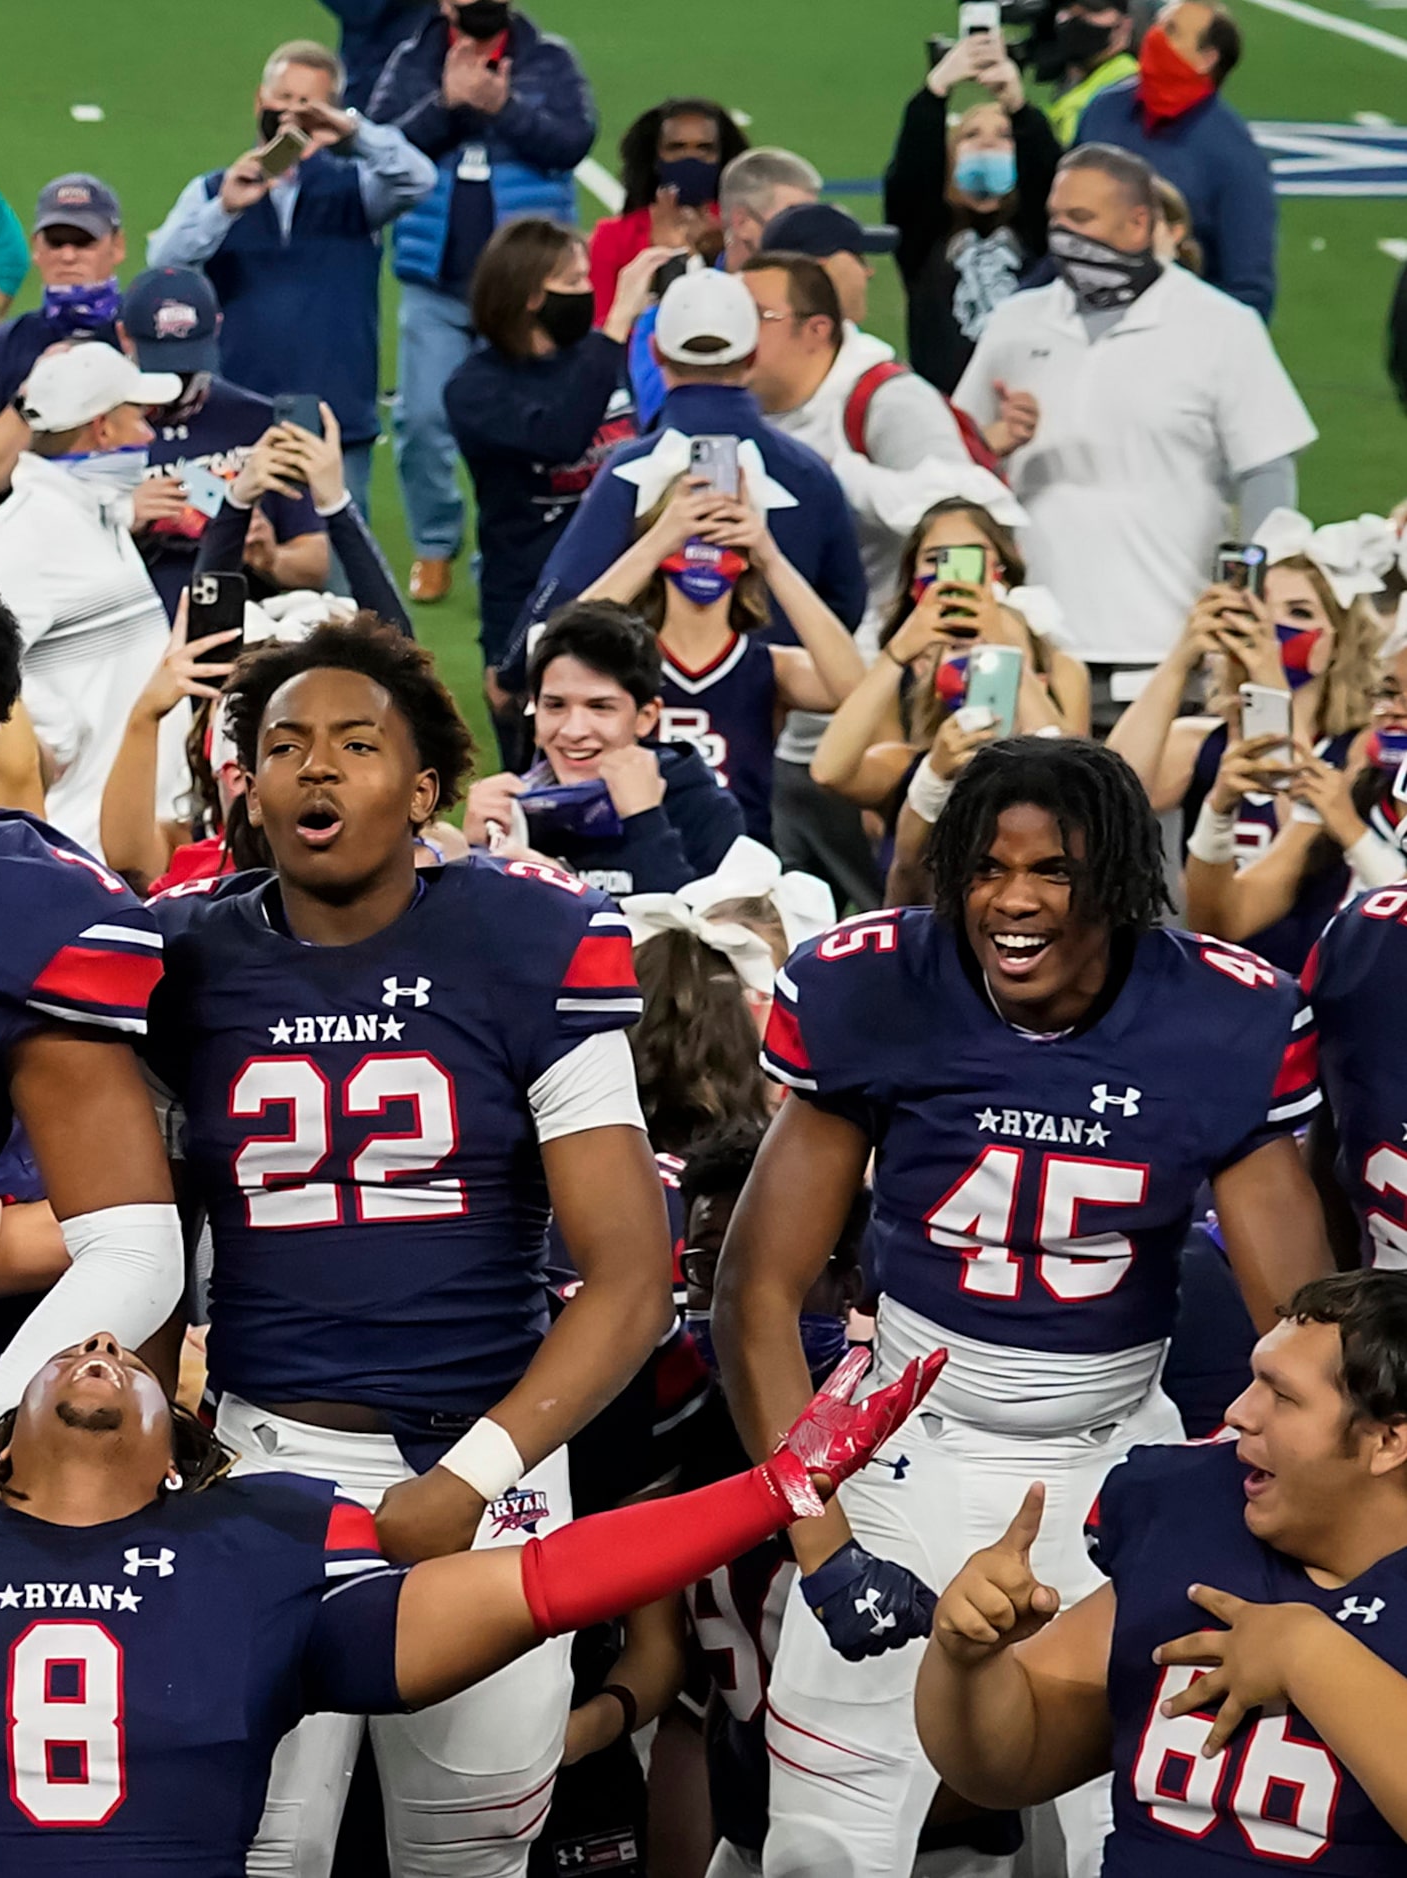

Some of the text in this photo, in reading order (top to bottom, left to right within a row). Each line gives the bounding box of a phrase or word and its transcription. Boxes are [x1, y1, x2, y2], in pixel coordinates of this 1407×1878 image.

[295, 1014, 379, 1044] RYAN
[227, 1050, 470, 1232] 22
[1000, 1109, 1086, 1145] RYAN
[922, 1143, 1150, 1304] 45
[494, 1493, 547, 1519] RYAN
[23, 1583, 115, 1611] RYAN
[5, 1618, 128, 1829] 8
[1130, 1627, 1343, 1865] 66
